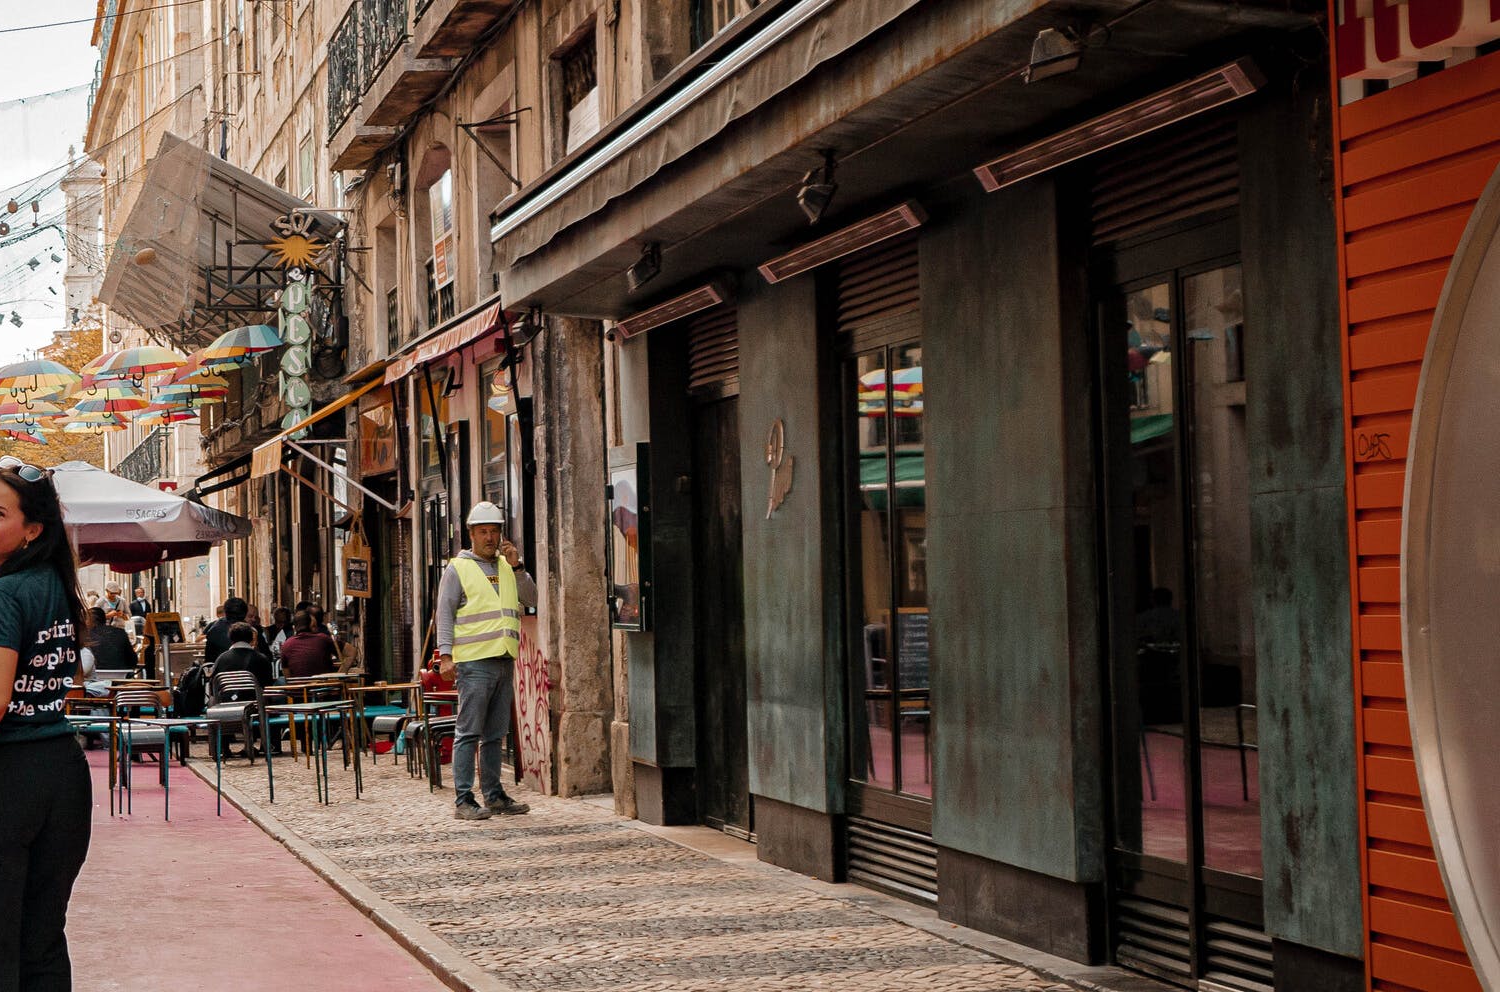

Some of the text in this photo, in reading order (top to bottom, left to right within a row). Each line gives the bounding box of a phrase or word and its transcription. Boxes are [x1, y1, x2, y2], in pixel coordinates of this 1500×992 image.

[274, 211, 315, 238] SOL
[135, 508, 167, 519] SAGRES
[8, 700, 35, 717] the
